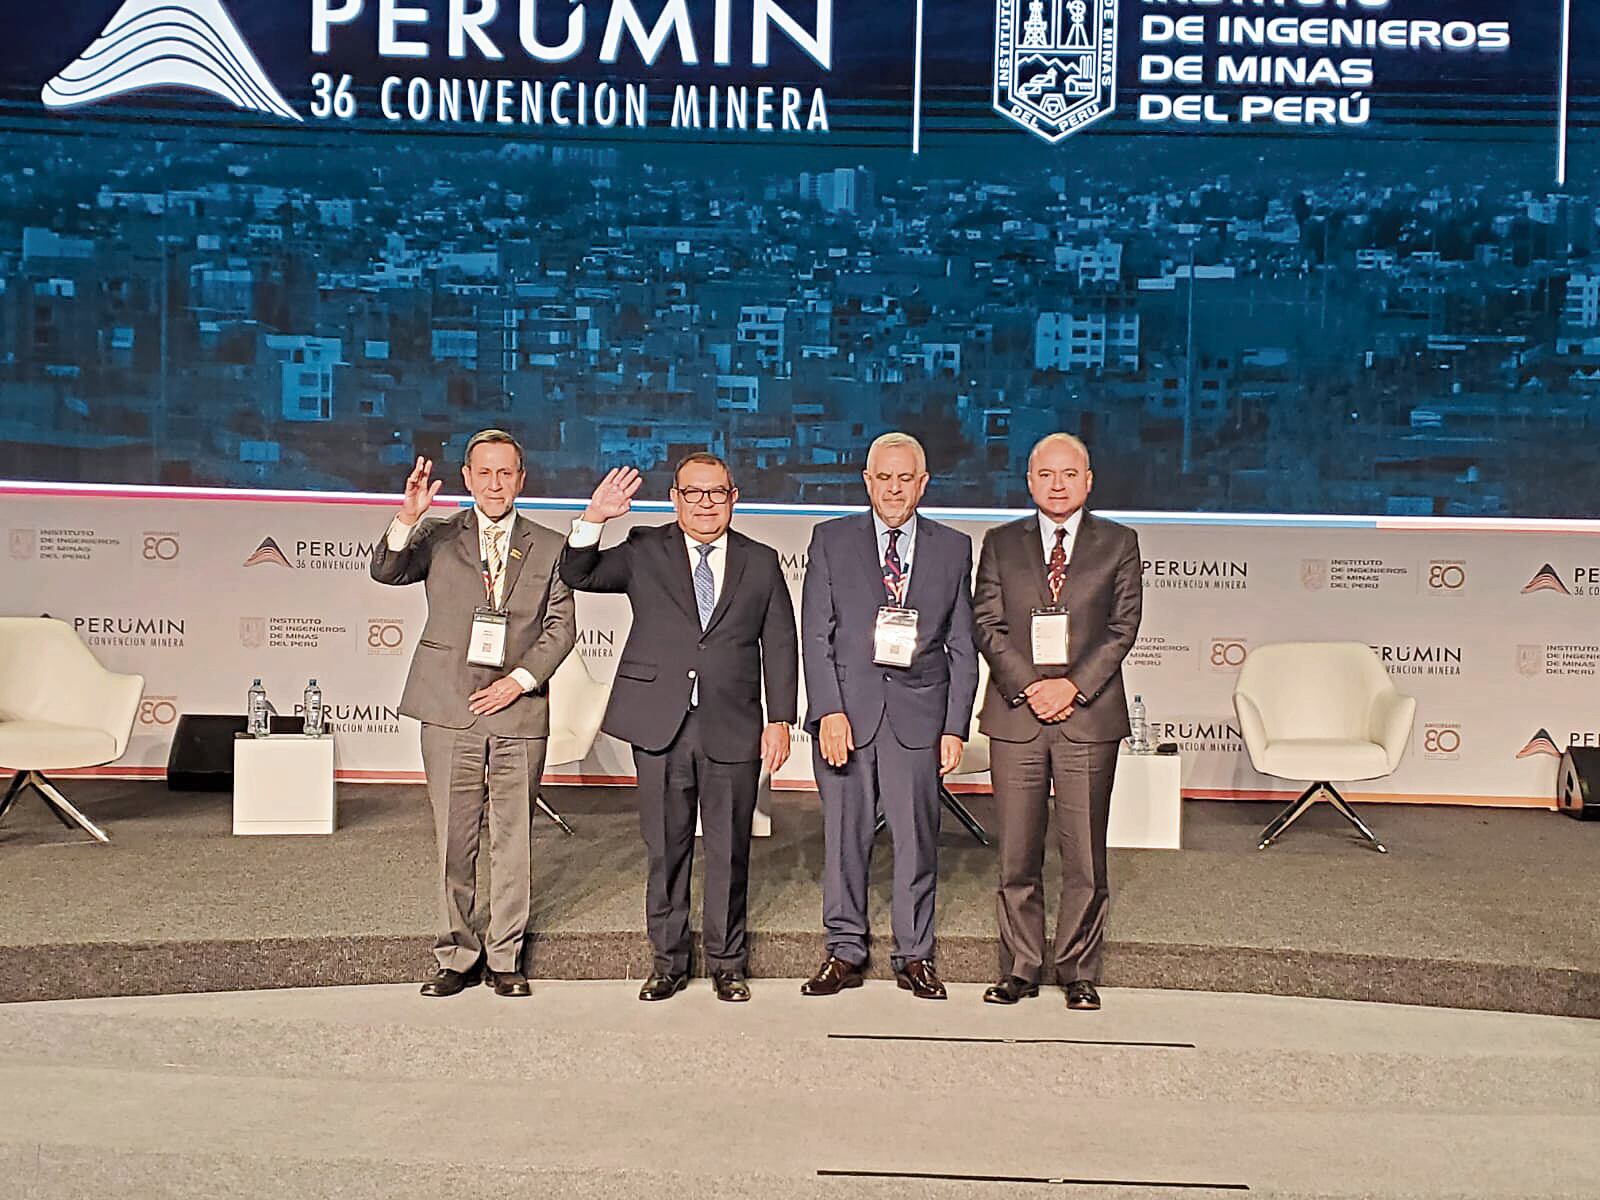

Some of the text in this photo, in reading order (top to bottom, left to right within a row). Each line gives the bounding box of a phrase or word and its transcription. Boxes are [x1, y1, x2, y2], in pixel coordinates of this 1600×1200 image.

[1141, 14, 1511, 51] DE INGENIEROS
[1101, 28, 1114, 86] MINAS
[1140, 54, 1374, 87] DE MINAS
[310, 72, 356, 118] 36
[670, 84, 830, 132] MINERA
[1010, 104, 1039, 128] DEL
[1138, 91, 1371, 126] DEL PERÚ
[270, 617, 322, 625] INSTITUTO
